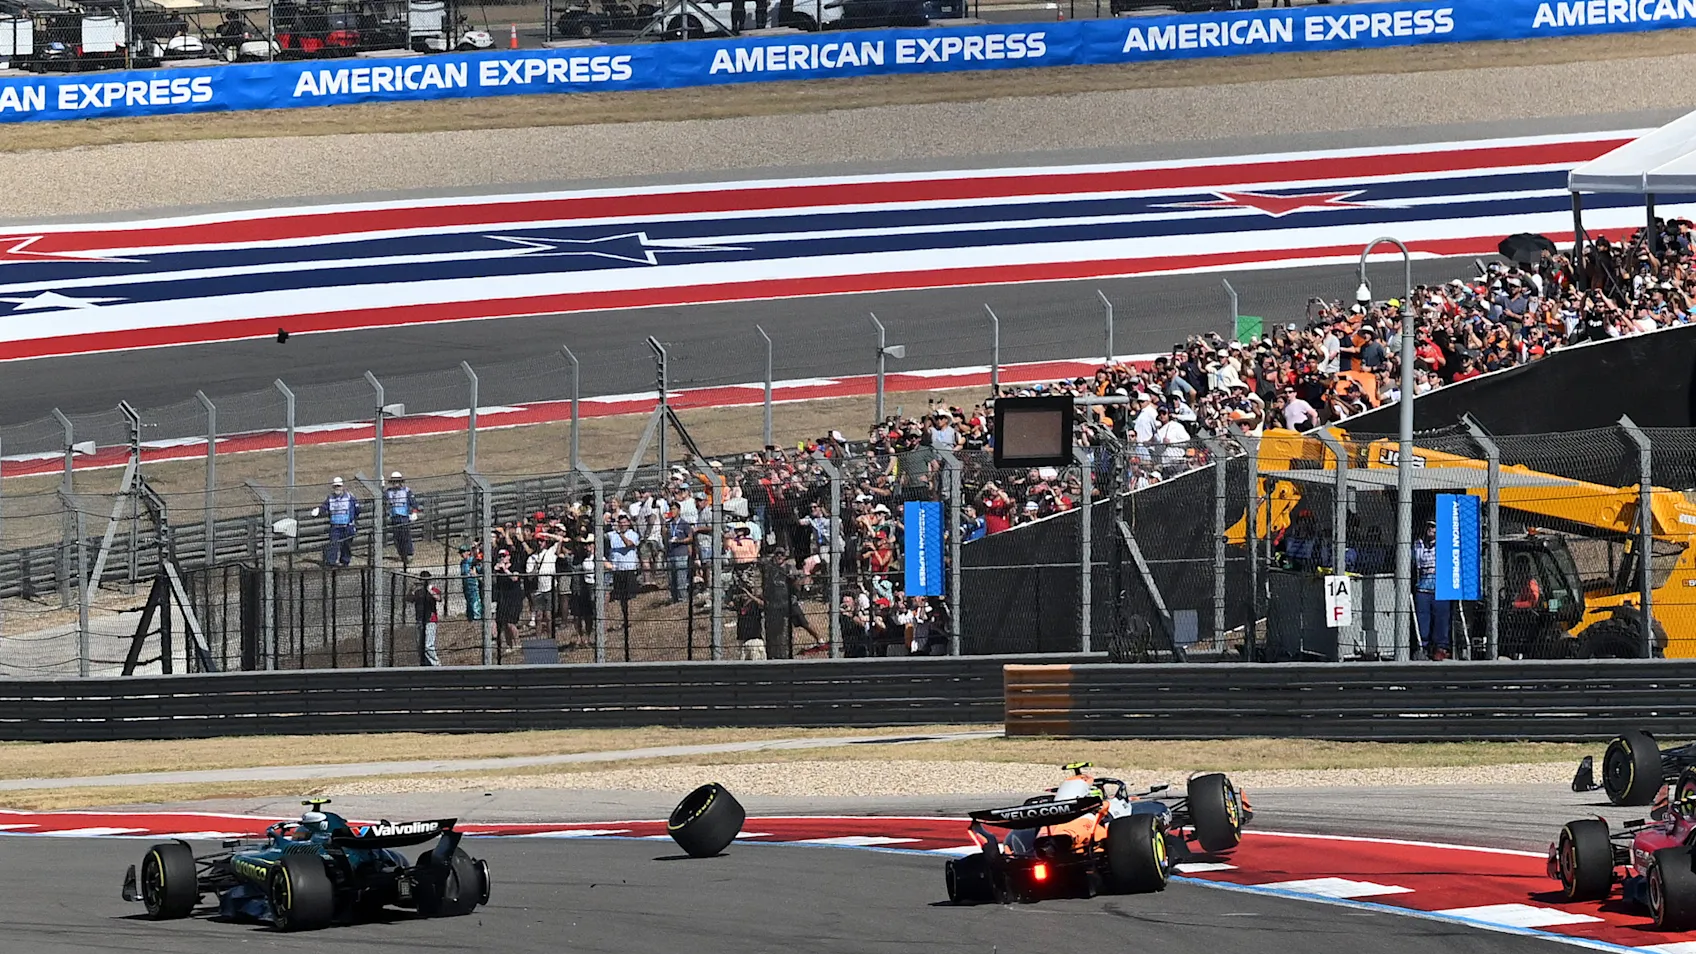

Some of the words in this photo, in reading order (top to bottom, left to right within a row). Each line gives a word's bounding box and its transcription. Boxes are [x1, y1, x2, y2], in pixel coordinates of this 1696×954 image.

[1121, 17, 1294, 53] AMERICAN
[1304, 8, 1455, 43] EXPRESS
[709, 41, 886, 75] AMERICAN
[895, 31, 1047, 65] EXPRESS
[57, 76, 213, 110] EXPRESS
[292, 63, 470, 98] AMERICAN
[479, 54, 633, 85] EXPRESS
[918, 508, 926, 549] AMERICAN
[1452, 500, 1461, 547] AMERICAN
[917, 551, 926, 587] EXPRESS
[1452, 549, 1461, 590] EXPRESS
[1327, 581, 1349, 597] 1A
[1333, 606, 1344, 621] F
[371, 821, 439, 838] Valvoline
[1000, 804, 1072, 821] VELO.COM
[235, 857, 268, 881] aramco
